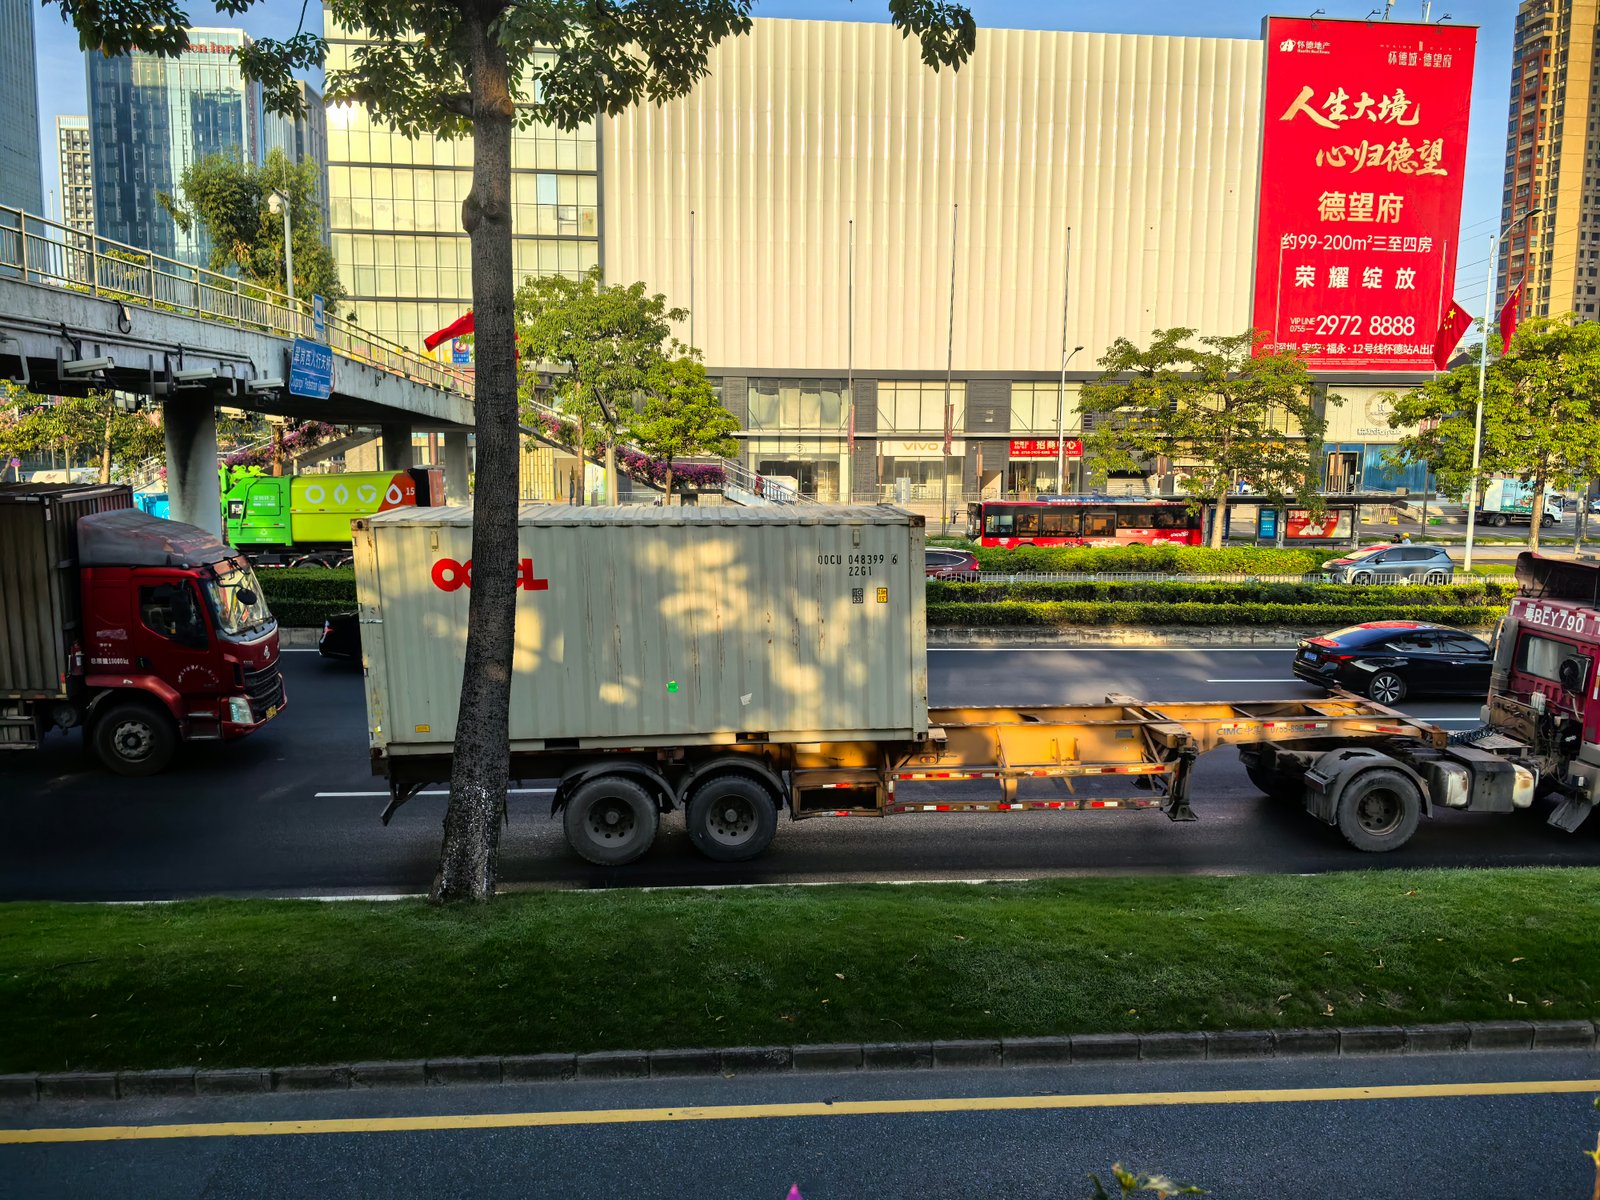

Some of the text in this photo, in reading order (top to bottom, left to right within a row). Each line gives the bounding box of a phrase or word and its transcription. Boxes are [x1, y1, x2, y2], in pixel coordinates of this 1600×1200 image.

[1279, 85, 1421, 129] 人生大境
[1315, 137, 1448, 176] 心归德望
[1317, 191, 1404, 224] 德望府
[1290, 317, 1315, 325] VIP LINE
[1315, 314, 1415, 336] 2972 8888
[406, 487, 415, 496] 15
[848, 554, 885, 565] 048399
[892, 554, 898, 565] 6
[848, 566, 872, 576] 22G1
[1216, 727, 1242, 736] CIMC
